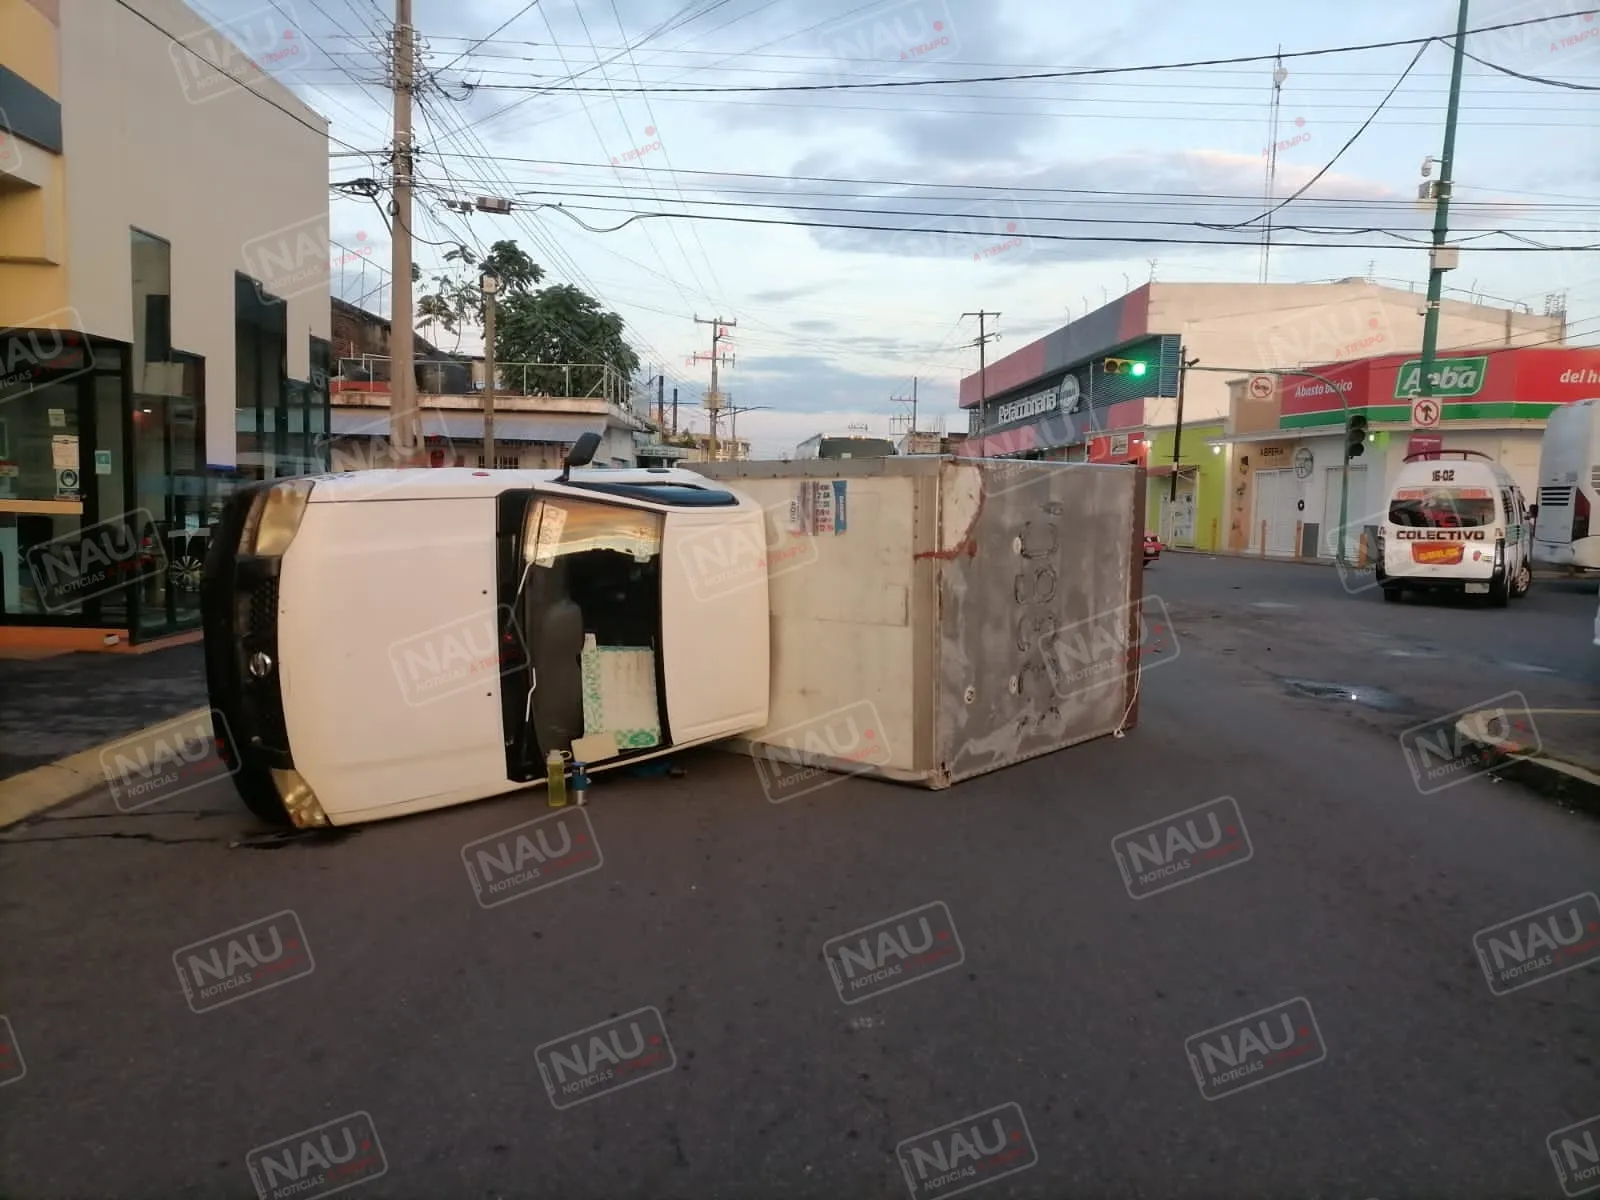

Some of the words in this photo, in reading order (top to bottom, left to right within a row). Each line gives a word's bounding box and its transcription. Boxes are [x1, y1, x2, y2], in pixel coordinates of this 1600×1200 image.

[1559, 368, 1586, 384] del
[1432, 470, 1455, 481] 16-02
[1396, 530, 1485, 541] COLECTIVO
